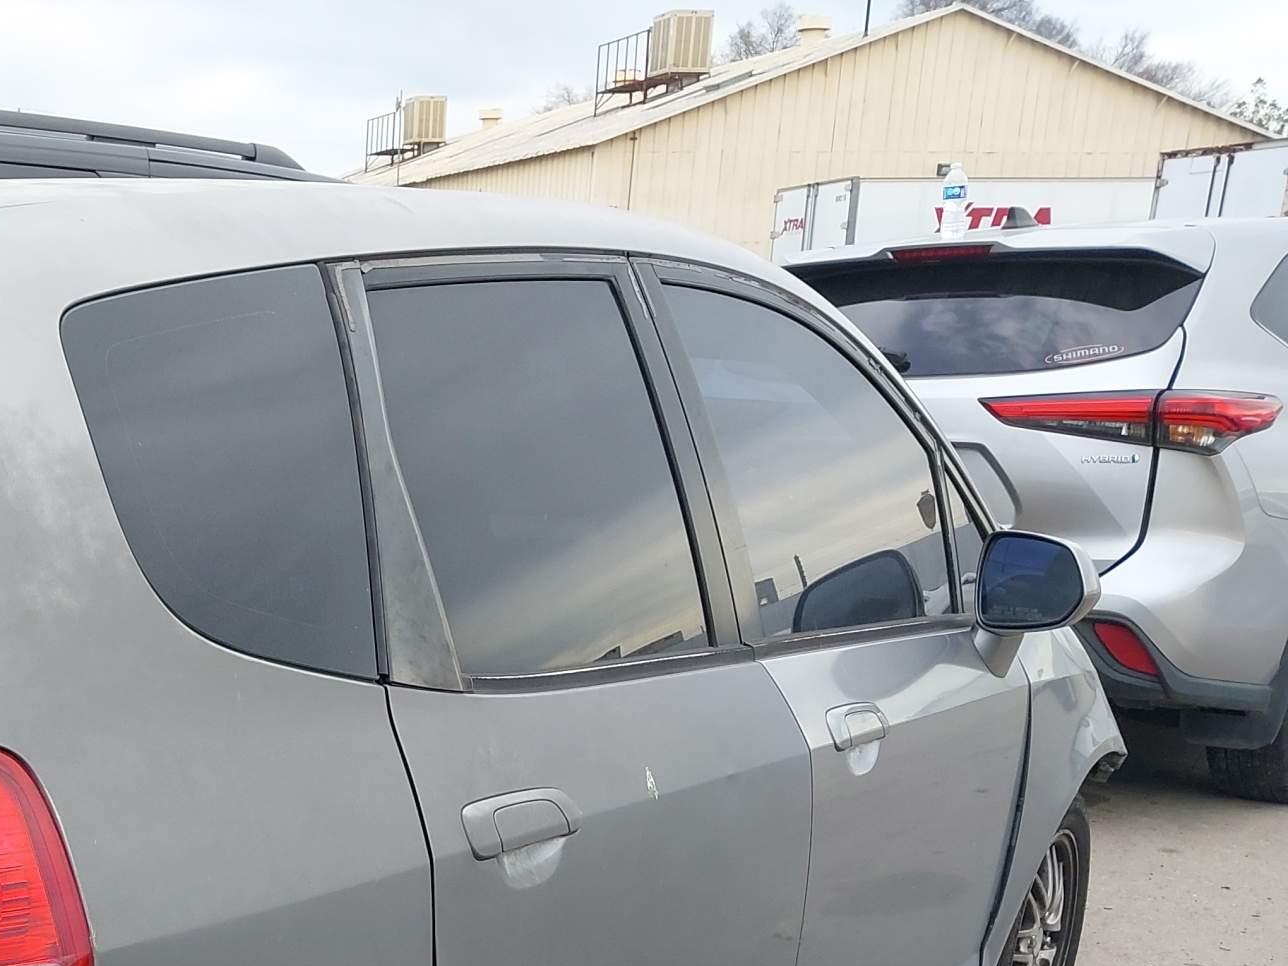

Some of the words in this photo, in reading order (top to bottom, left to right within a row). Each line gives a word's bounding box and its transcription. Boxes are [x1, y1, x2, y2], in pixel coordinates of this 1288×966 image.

[780, 217, 807, 235] XTRA
[1053, 345, 1119, 362] SHIMANO
[1080, 455, 1130, 464] HYBRID
